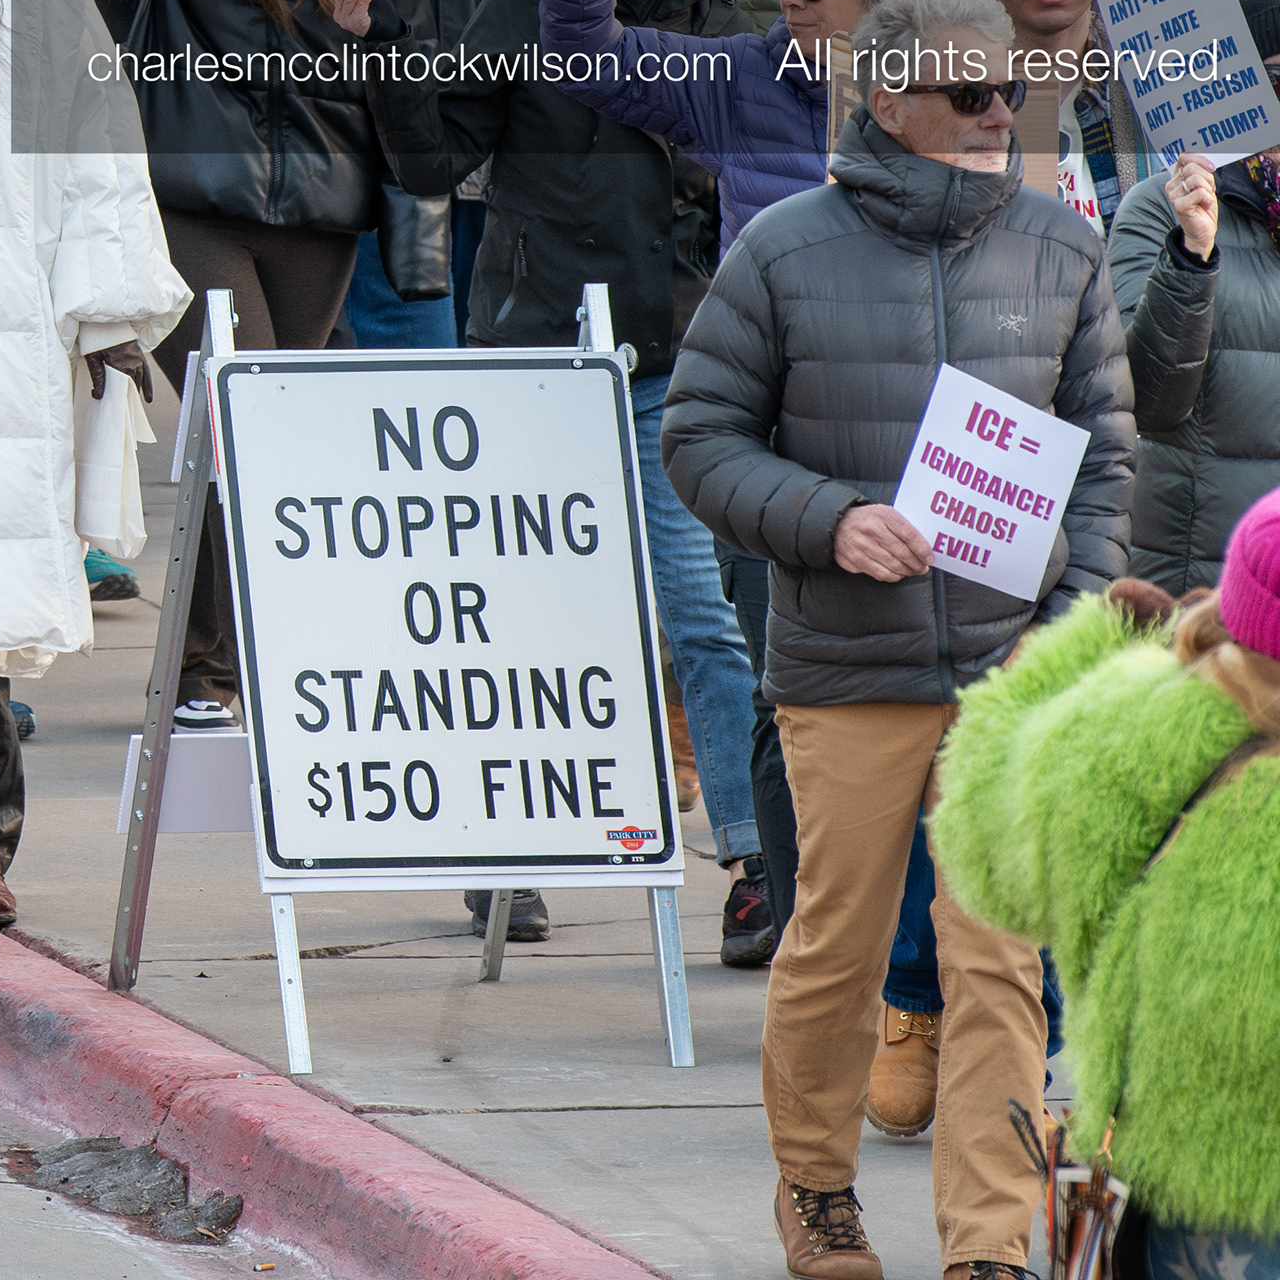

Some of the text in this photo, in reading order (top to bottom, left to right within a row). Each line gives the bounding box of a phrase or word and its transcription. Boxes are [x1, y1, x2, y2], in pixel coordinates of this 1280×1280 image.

[1120, 10, 1200, 62] ANTI HATE
[1133, 66, 1166, 98] ANTI
[1145, 66, 1260, 132] ANTI FASCISM
[1161, 105, 1269, 167] ANTI TRUMP!
[372, 404, 480, 473] NO
[964, 401, 1017, 452] ICE
[920, 440, 1056, 523] IGNORANCE!
[274, 491, 600, 560] STOPPING
[930, 489, 1018, 545] CHAOS!
[932, 531, 992, 570] EVIL!
[403, 581, 492, 645] OR
[294, 665, 618, 733] STANDING
[306, 757, 625, 823] $150 FINE
